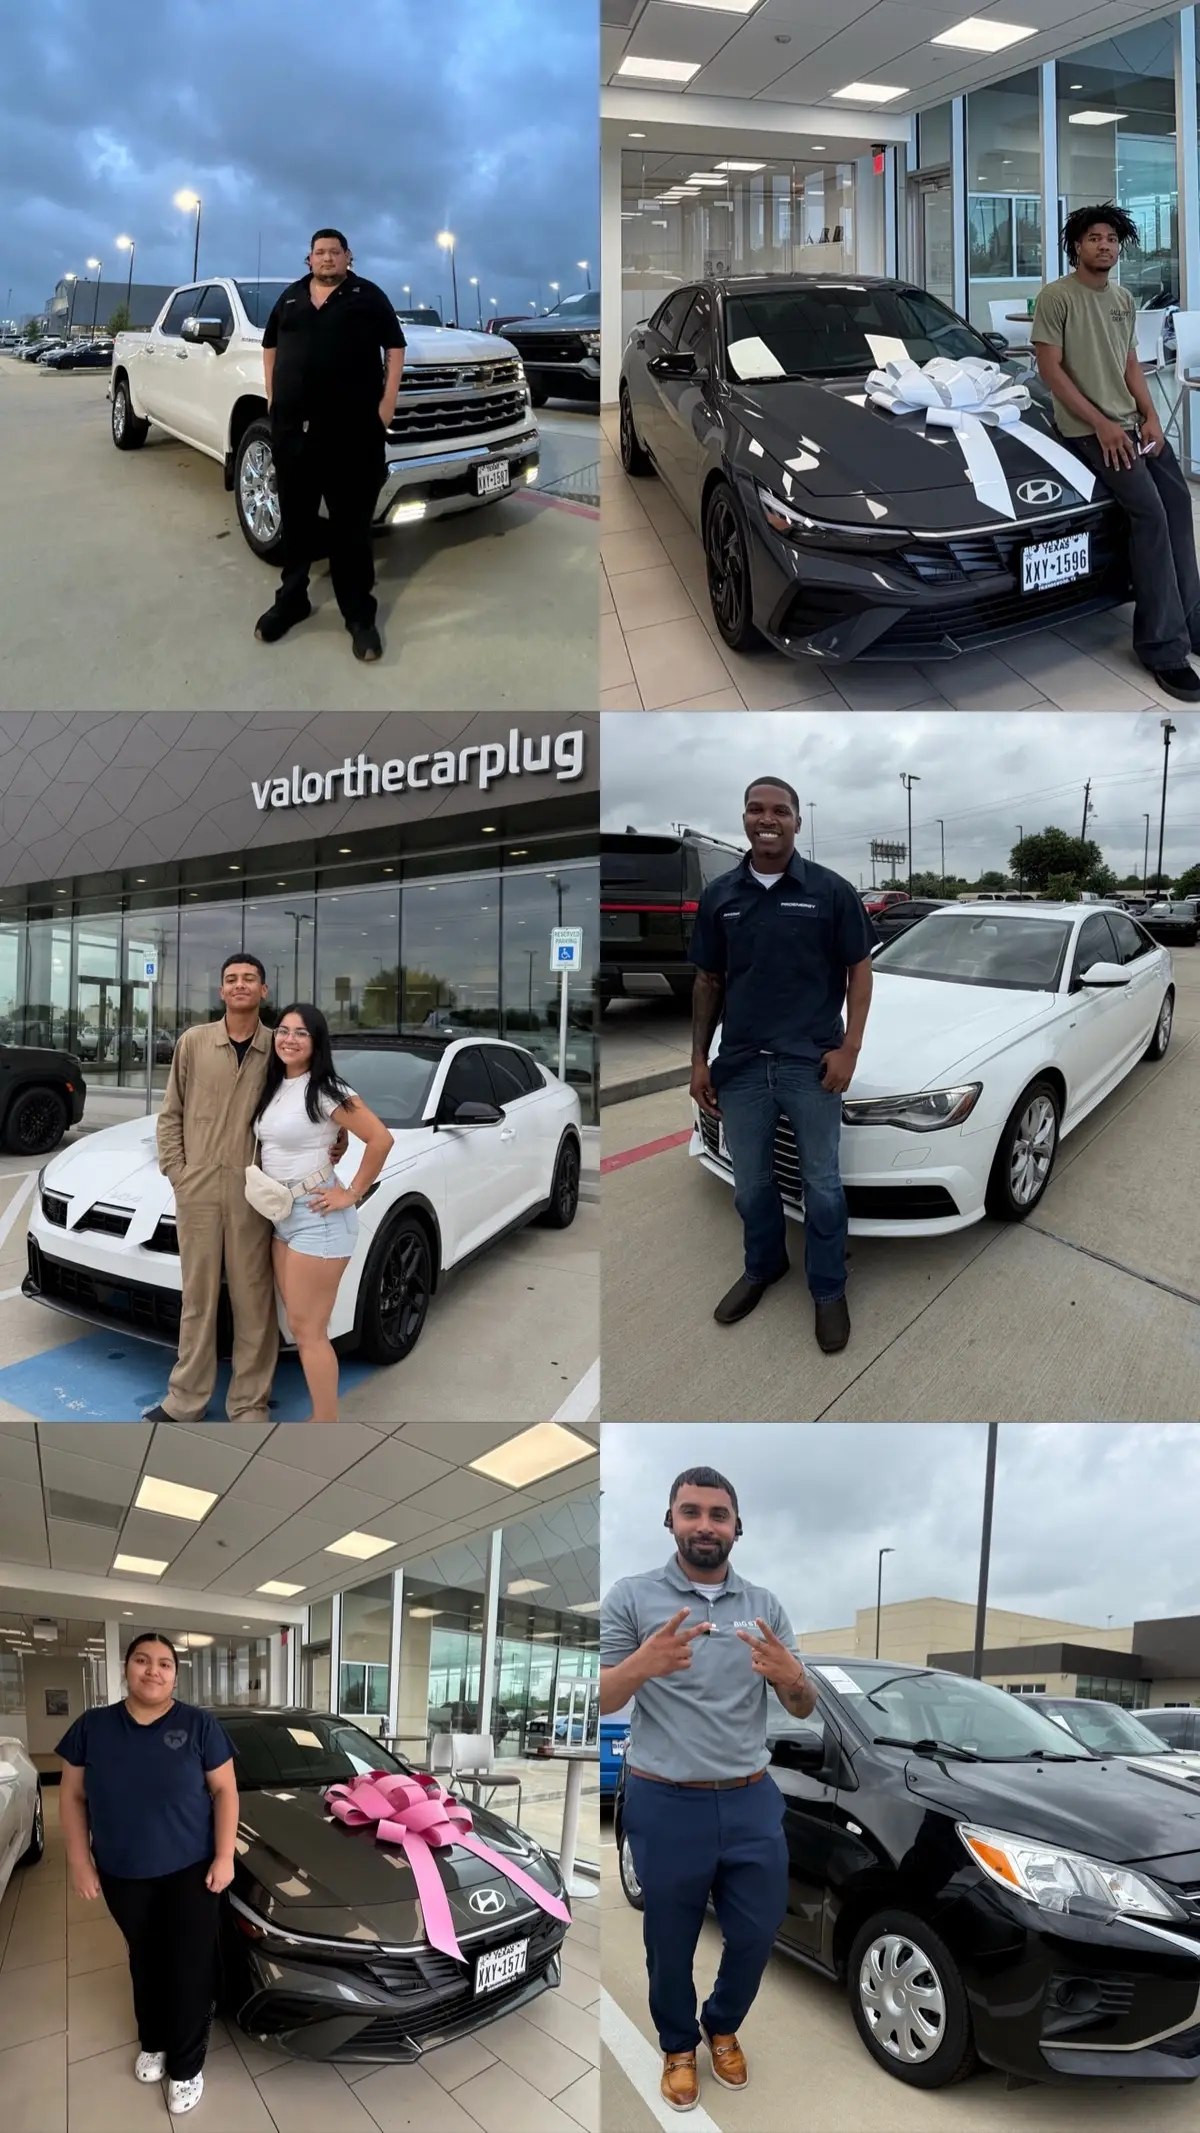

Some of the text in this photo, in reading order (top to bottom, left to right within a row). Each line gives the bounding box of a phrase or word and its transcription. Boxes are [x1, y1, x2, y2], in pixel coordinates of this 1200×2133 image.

[1042, 542, 1070, 555] TEXAS
[251, 728, 585, 811] valorthecarplug
[733, 1620, 747, 1628] BIG
